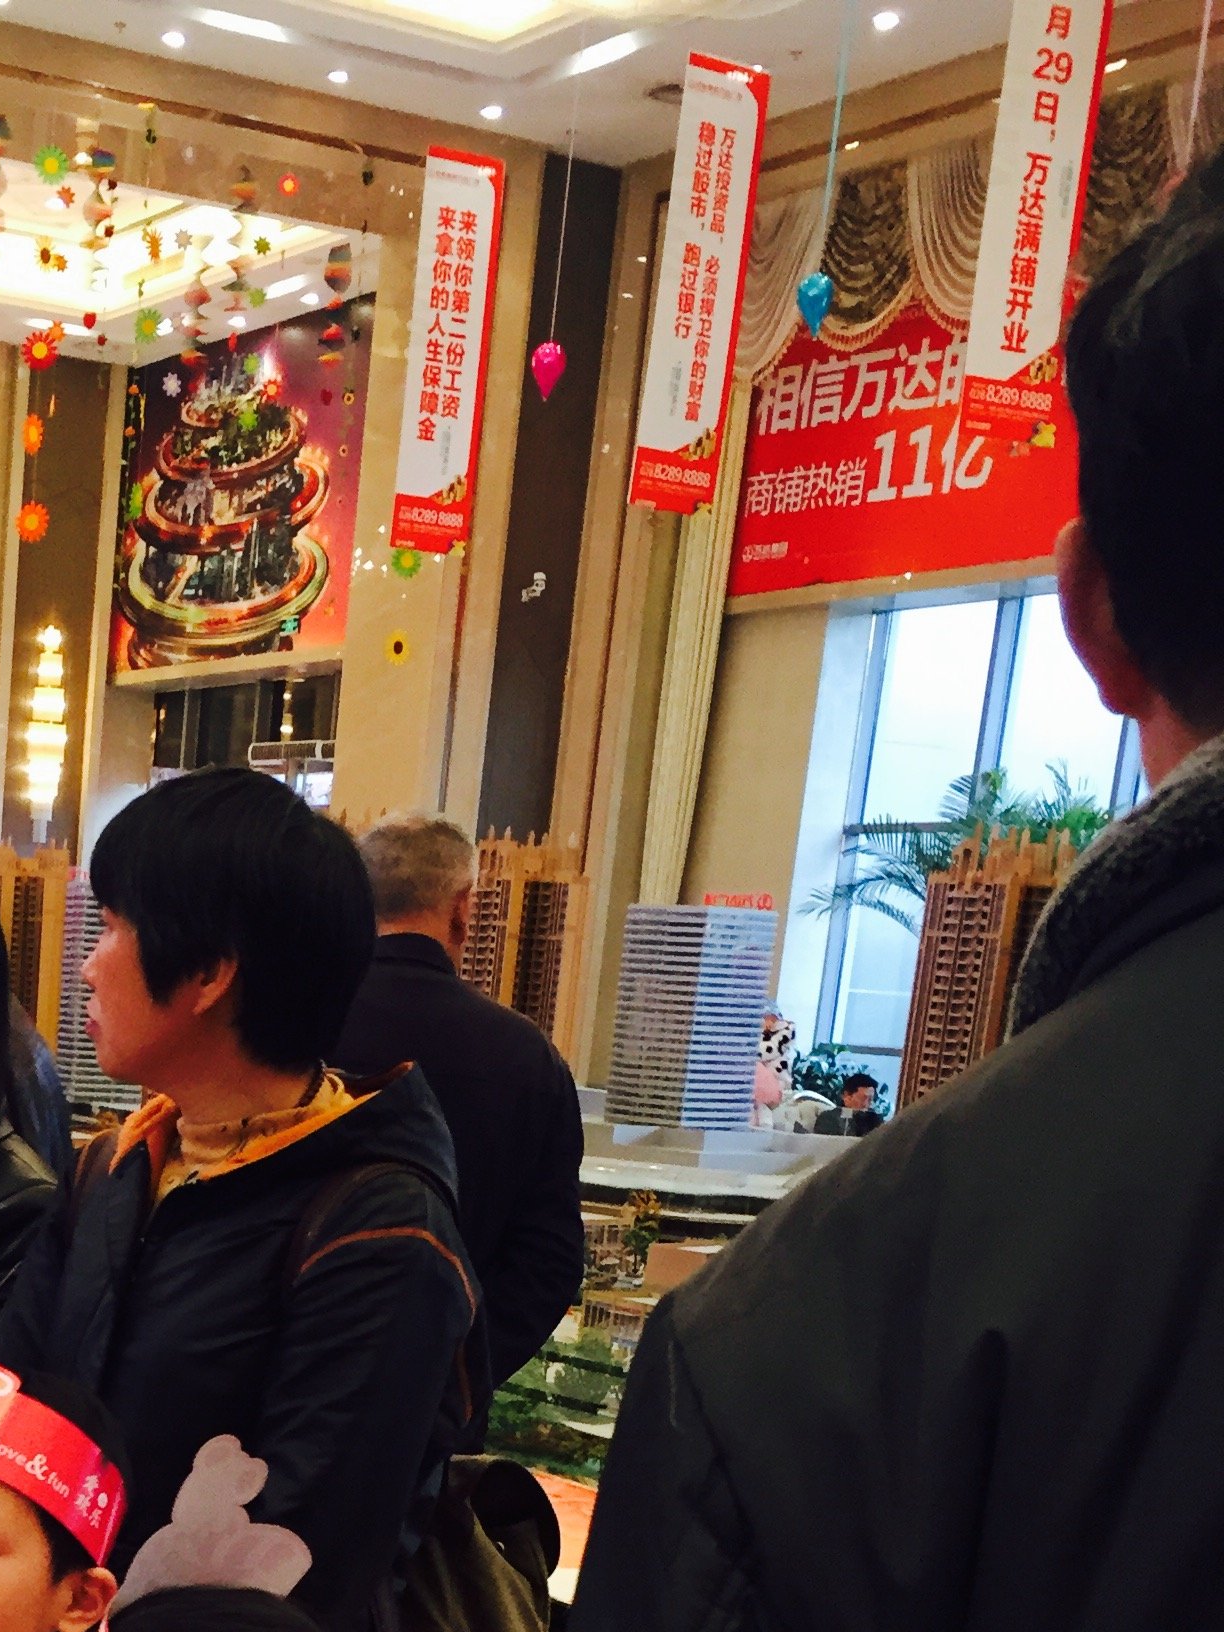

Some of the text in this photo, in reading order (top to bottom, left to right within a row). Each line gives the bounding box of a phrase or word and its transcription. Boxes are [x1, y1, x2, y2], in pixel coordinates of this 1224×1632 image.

[416, 205, 456, 442] 来拿你的人生保障金
[440, 209, 478, 420] 来领你第二份工资
